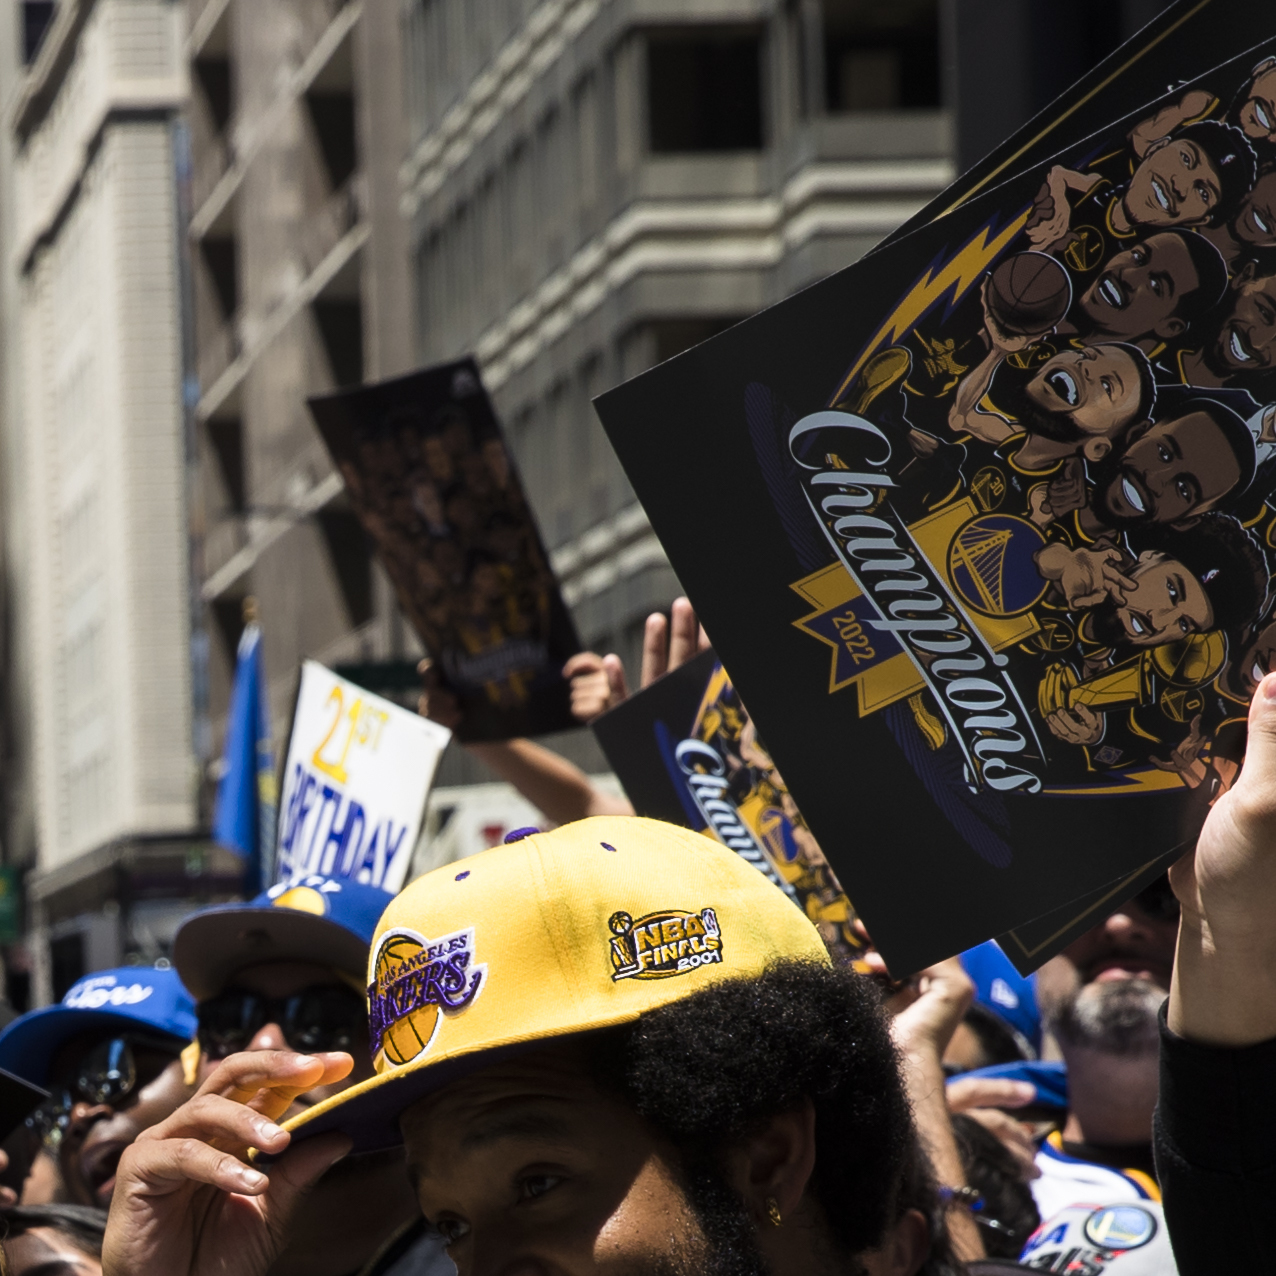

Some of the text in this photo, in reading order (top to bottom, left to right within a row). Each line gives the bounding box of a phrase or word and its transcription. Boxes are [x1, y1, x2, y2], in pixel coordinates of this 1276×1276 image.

[789, 411, 1042, 794] Champions
[832, 610, 877, 666] 2022
[634, 914, 707, 952] NBA
[636, 935, 720, 969] FINALS
[397, 934, 468, 976] ANGELES
[677, 949, 722, 971] 2001
